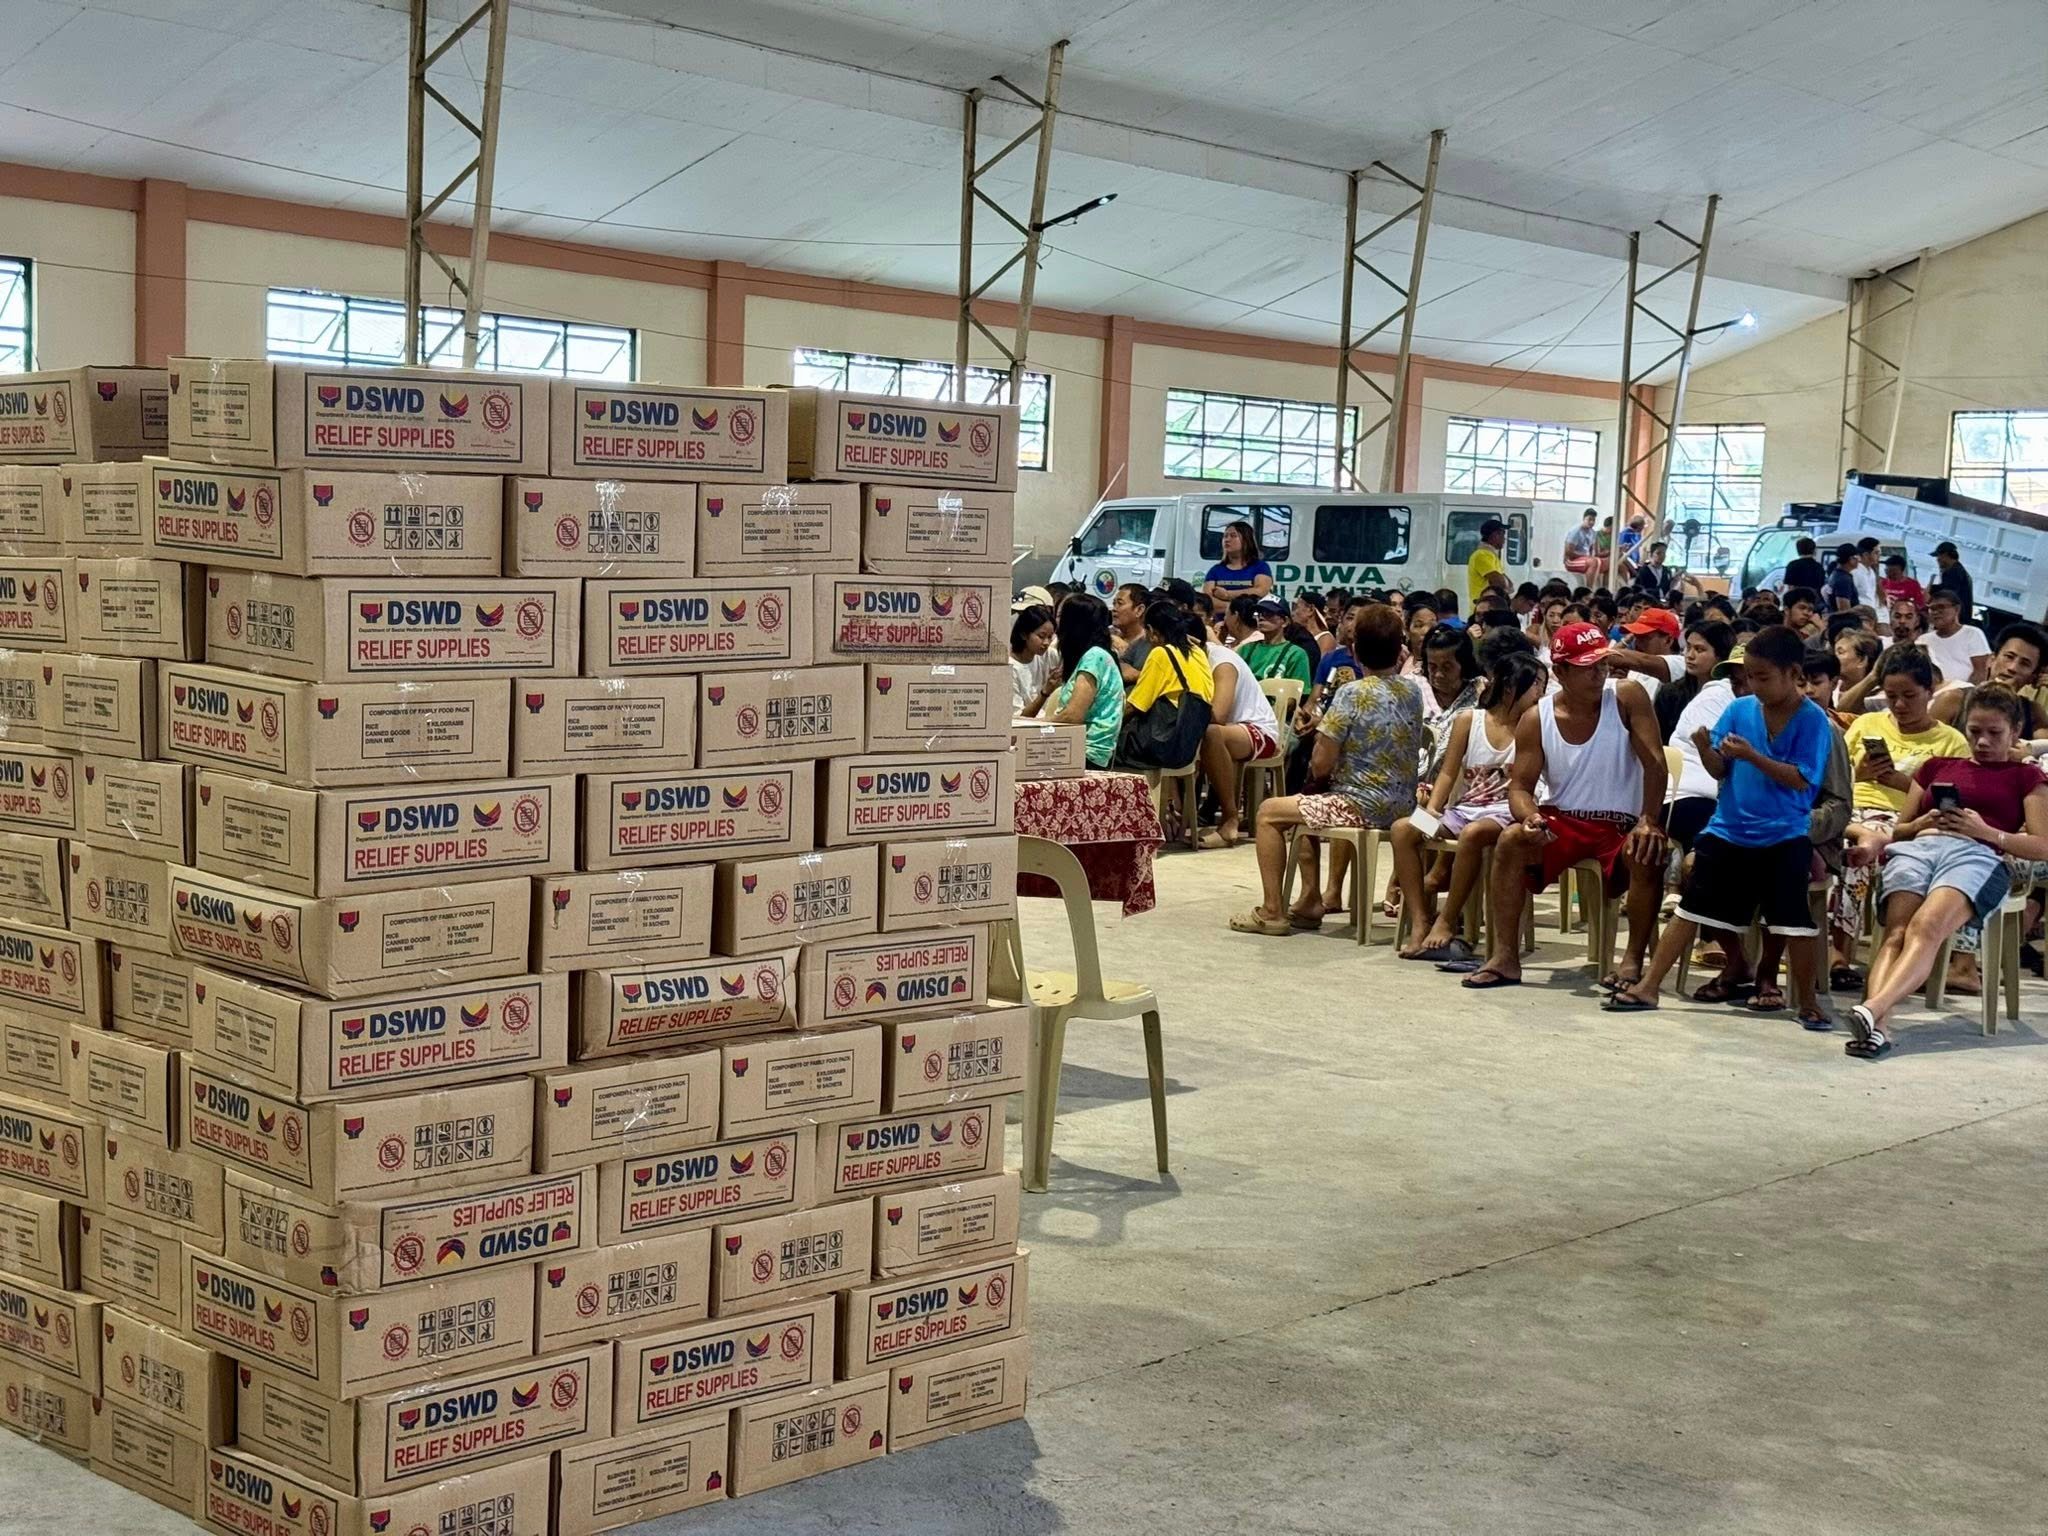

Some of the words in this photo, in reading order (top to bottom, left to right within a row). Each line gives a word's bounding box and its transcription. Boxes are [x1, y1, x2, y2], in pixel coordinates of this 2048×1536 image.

[346, 385, 424, 413] DSWD
[611, 400, 679, 425] DSWD
[315, 425, 373, 446] RELIEF
[378, 427, 454, 449] SUPPLIES
[869, 413, 926, 438] DSWD
[583, 436, 633, 456] RELIEF
[637, 439, 705, 459] SUPPLIES
[845, 445, 888, 464] RELIEF
[891, 448, 948, 468] SUPPLIES
[174, 479, 219, 506] DSWD
[159, 516, 190, 538] RELIEF
[193, 520, 238, 543] SUPPLIES
[1276, 564, 1386, 585] DIWA
[388, 601, 461, 625] DSWD
[644, 598, 708, 622] DSWD
[864, 591, 921, 613] DSWD
[618, 635, 666, 655] RELIEF
[670, 632, 735, 651] SUPPLIES
[841, 625, 885, 643] RELIEF
[887, 626, 943, 644] SUPPLIES
[358, 640, 413, 660] RELIEF
[417, 638, 490, 658] SUPPLIES
[188, 686, 228, 716] DSWD
[786, 699, 796, 707] 10
[173, 721, 202, 743] RELIEF
[204, 727, 246, 753] SUPPLIES
[877, 772, 930, 794] DSWD
[5, 794, 41, 814] SUPPLIES
[646, 786, 710, 811] DSWD
[385, 803, 459, 832] DSWD
[855, 805, 894, 824] RELIEF
[898, 802, 950, 821] SUPPLIES
[619, 824, 667, 845] RELIEF
[671, 819, 734, 841] SUPPLIES
[355, 845, 410, 869] RELIEF
[415, 839, 487, 864] SUPPLIES
[190, 892, 235, 925] DSWD
[180, 924, 214, 948] RELIEF
[215, 934, 263, 961] SUPPLIES
[932, 946, 968, 965] RELIEF
[877, 951, 929, 971] SUPPLIES
[14, 971, 51, 994] SUPPLIES
[645, 976, 710, 1003] DSWD
[897, 976, 948, 1001] DSWD
[370, 1006, 446, 1038] DSWD
[618, 1014, 667, 1036] RELIEF
[668, 1006, 733, 1028] SUPPLIES
[339, 1050, 396, 1076] RELIEF
[400, 1038, 475, 1068] SUPPLIES
[208, 1085, 250, 1121] DSWD
[193, 1116, 223, 1142] RELIEF
[224, 1127, 269, 1162] SUPPLIES
[867, 1123, 920, 1150] DSWD
[11, 1150, 50, 1176] SUPPLIES
[656, 1154, 718, 1186] DSWD
[843, 1160, 884, 1182] RELIEF
[886, 1152, 941, 1175] SUPPLIES
[527, 1185, 574, 1212] RELIEF
[630, 1197, 676, 1221] RELIEF
[679, 1185, 741, 1212] SUPPLIES
[454, 1199, 525, 1228] SUPPLIES
[480, 1223, 549, 1259] DSWD
[629, 1272, 640, 1280] 10
[211, 1273, 255, 1310] DSWD
[896, 1287, 949, 1318] DSWD
[196, 1304, 227, 1331] RELIEF
[228, 1318, 275, 1352] SUPPLIES
[874, 1327, 913, 1353] RELIEF
[915, 1315, 968, 1342] SUPPLIES
[673, 1340, 735, 1374] DSWD
[647, 1383, 694, 1410] RELIEF
[697, 1368, 758, 1398] SUPPLIES
[425, 1389, 498, 1428] DSWD
[395, 1437, 449, 1468] RELIEF
[452, 1419, 525, 1453] SUPPLIES
[225, 1464, 272, 1505] DSWD
[209, 1493, 241, 1521] RELIEF
[243, 1509, 291, 1536] SUPPLIES
